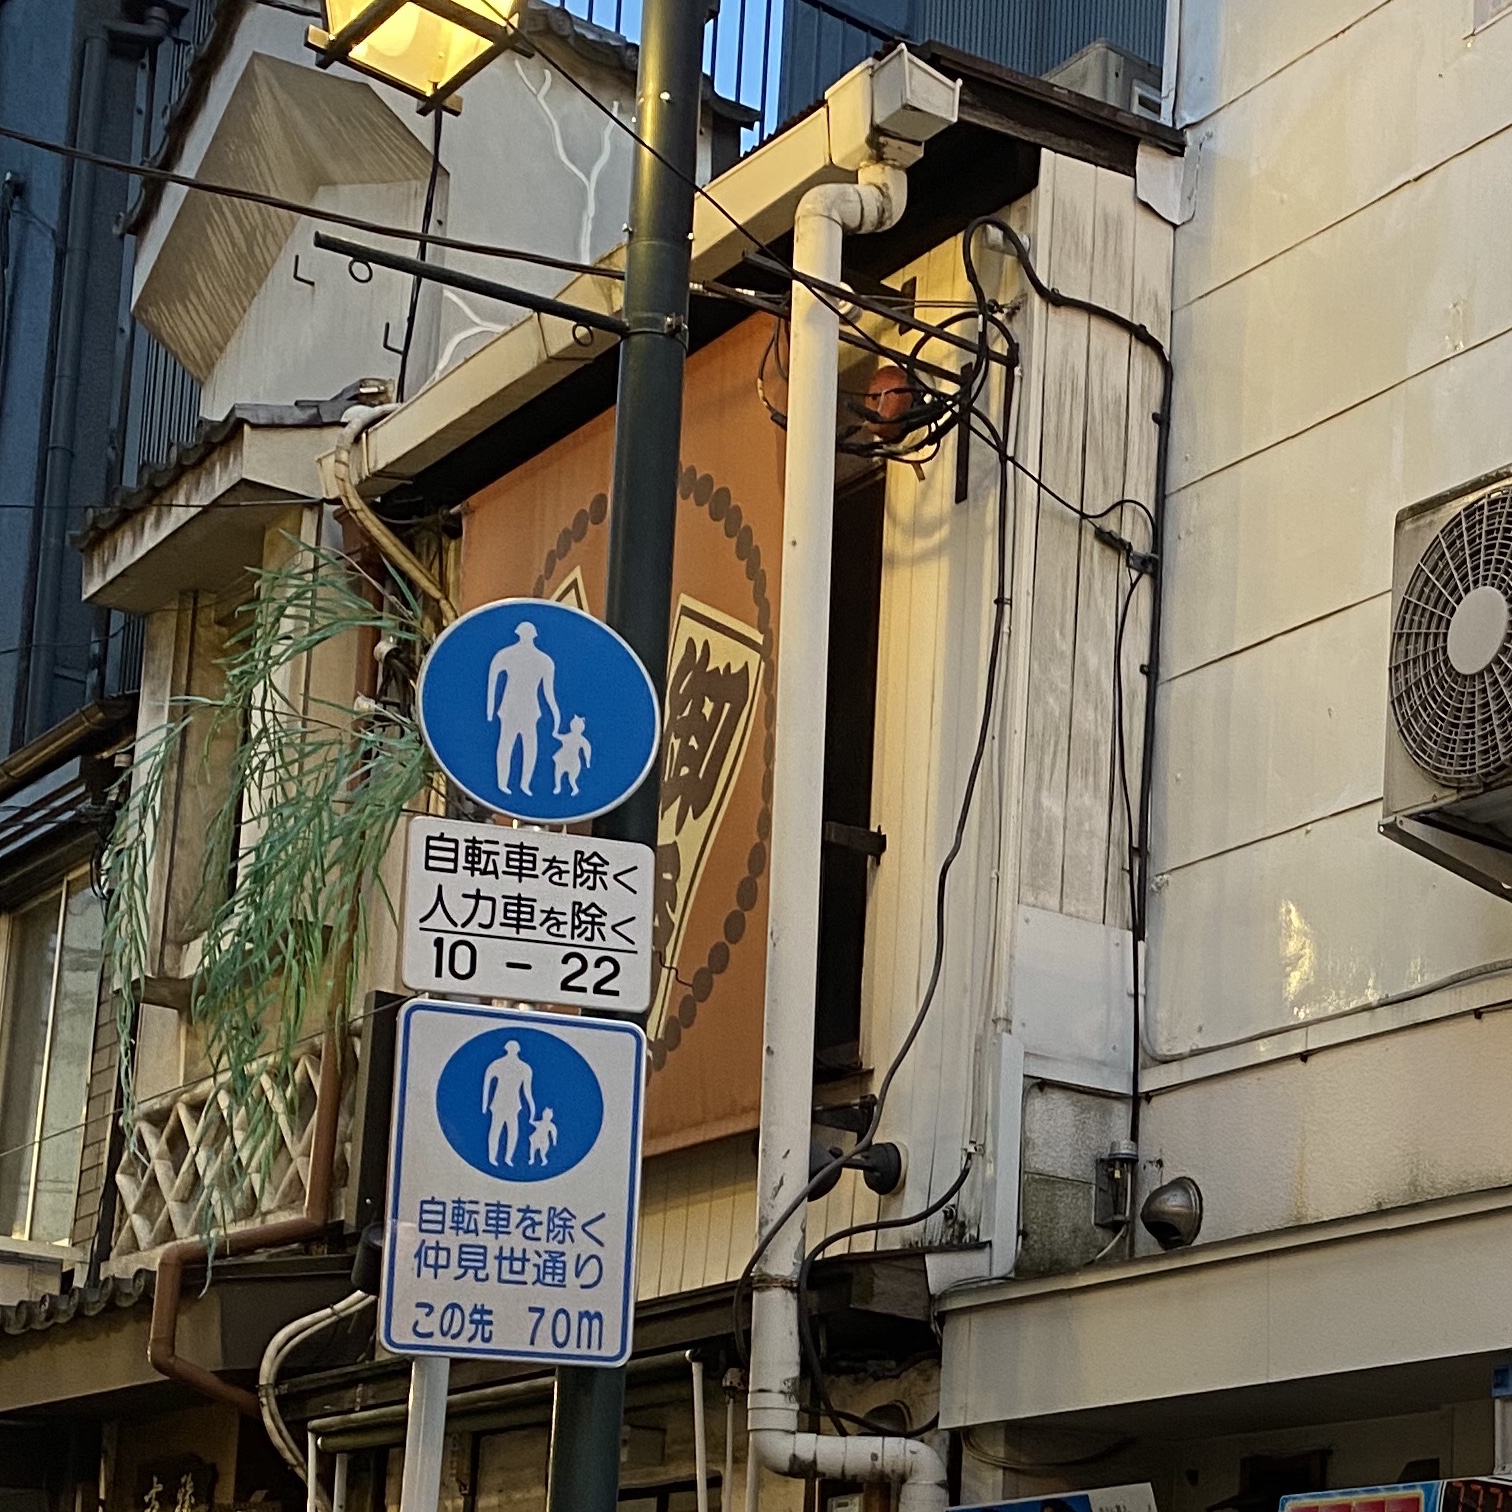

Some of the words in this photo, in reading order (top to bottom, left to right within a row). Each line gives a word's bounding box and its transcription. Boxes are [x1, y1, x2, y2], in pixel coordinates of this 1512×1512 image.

[422, 832, 640, 896] 自転車を除く
[419, 884, 638, 946] 人力車を除く
[432, 935, 477, 982] 10
[560, 955, 621, 996] 22
[418, 1199, 606, 1248] 自転車を除く
[413, 1239, 605, 1290] 仲見世通り
[411, 1300, 494, 1344] この先
[527, 1307, 603, 1351] 70m
